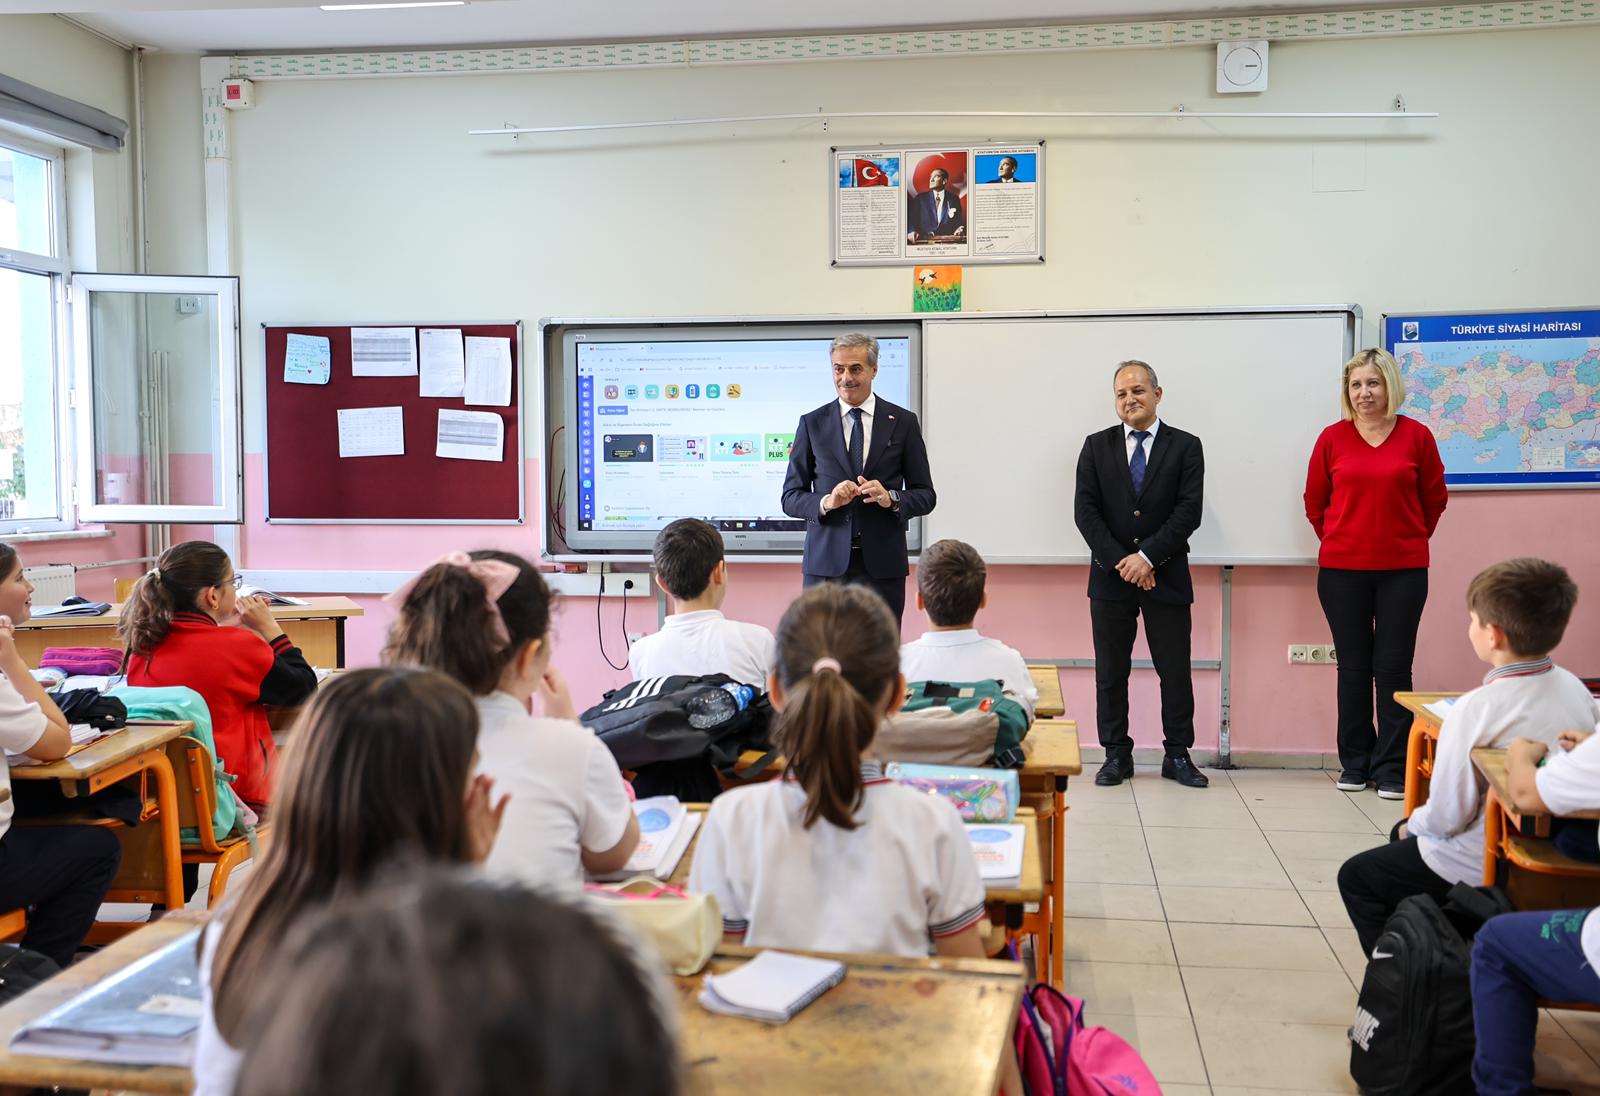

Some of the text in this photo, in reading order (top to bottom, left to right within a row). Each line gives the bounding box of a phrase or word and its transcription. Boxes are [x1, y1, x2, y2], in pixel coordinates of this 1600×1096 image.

[1451, 321, 1581, 335] TÜRKİYE SİYASİ HARİTASI
